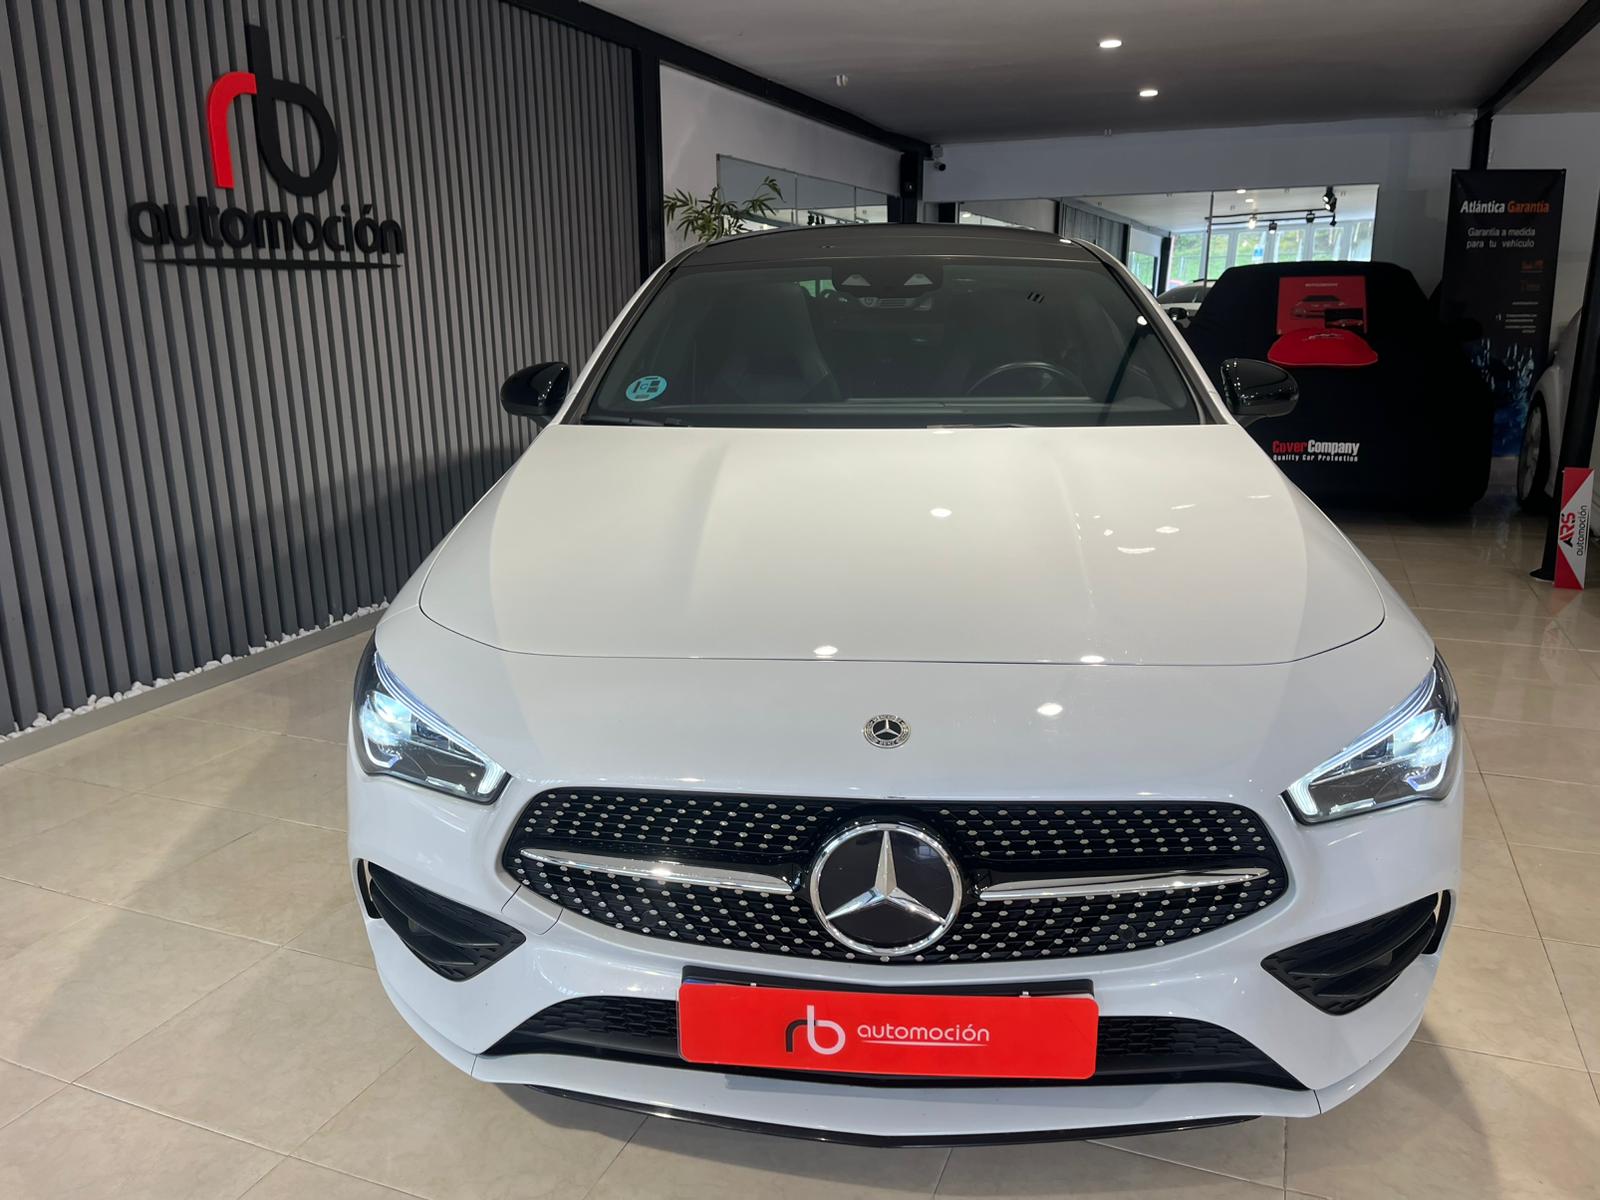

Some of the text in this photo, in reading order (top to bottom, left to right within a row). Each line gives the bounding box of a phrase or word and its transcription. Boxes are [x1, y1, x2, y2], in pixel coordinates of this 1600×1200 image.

[1460, 200, 1505, 214] Atlántica
[128, 196, 404, 255] automoción
[1501, 229, 1507, 237] a
[1508, 227, 1536, 237] medida
[1466, 239, 1535, 249] para tu vehículo
[1273, 454, 1299, 462] Quality
[1560, 512, 1575, 547] ARS
[857, 1023, 990, 1042] automoción
